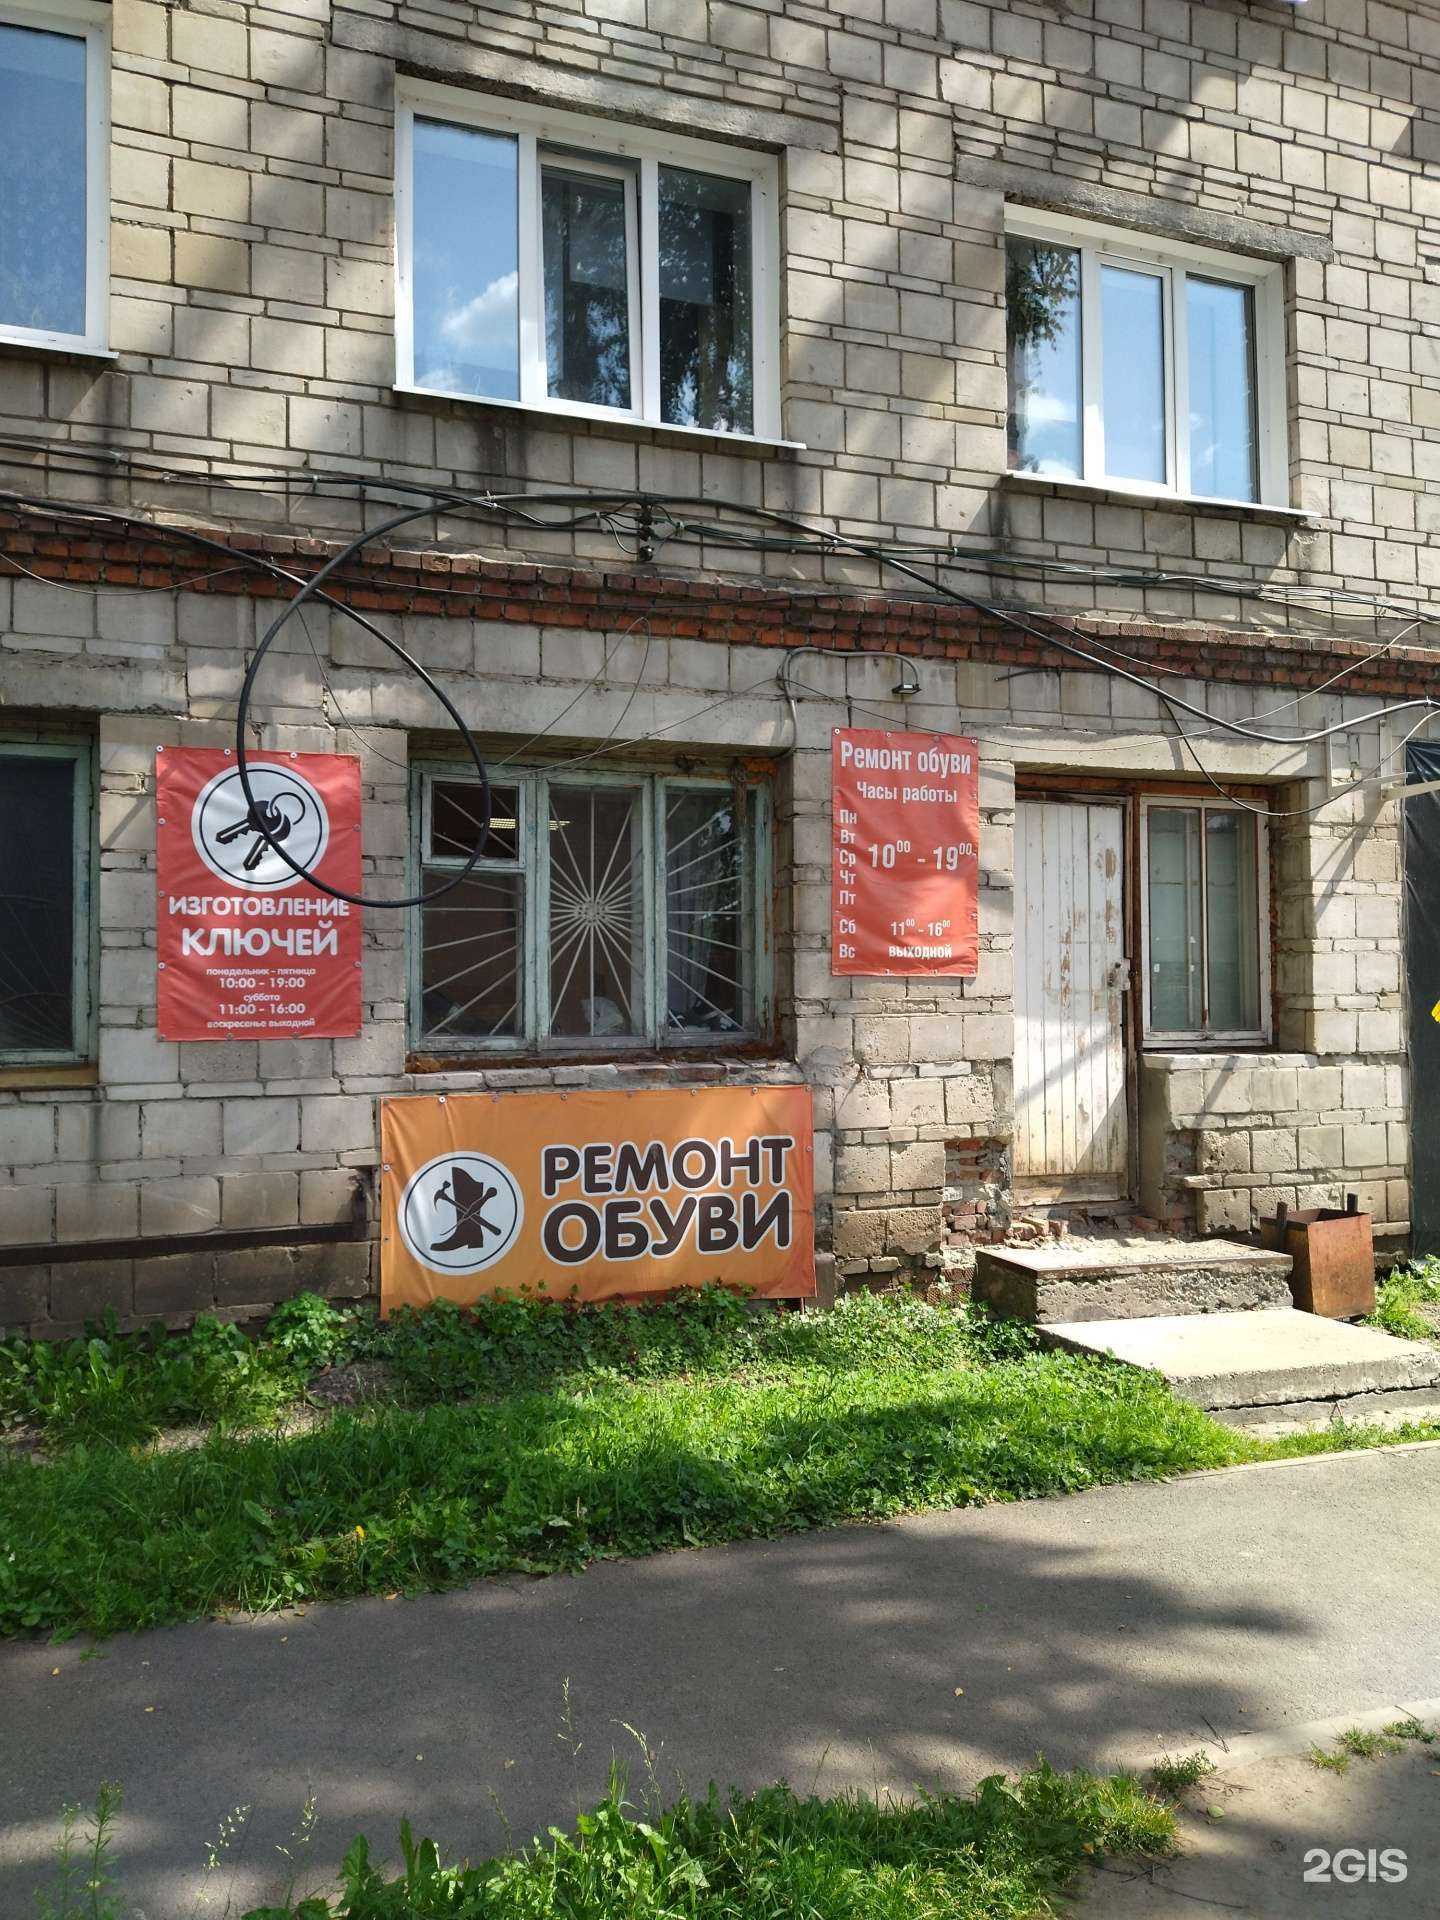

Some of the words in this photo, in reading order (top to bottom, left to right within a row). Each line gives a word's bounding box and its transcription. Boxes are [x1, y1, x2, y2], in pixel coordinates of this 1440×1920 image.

[917, 747, 971, 778] обуви
[857, 781, 898, 800] Часы
[903, 785, 957, 803] работы
[840, 830, 856, 844] Вт
[839, 850, 857, 867] Ср
[839, 870, 857, 885] Чт
[839, 890, 857, 905] Пт
[169, 897, 350, 916] ИЗГОТОВЛЕНИЕ
[839, 919, 857, 934] Сб
[182, 920, 338, 956] КЛЮЧЕЙ
[839, 943, 856, 959] Вс
[206, 967, 270, 976] понедельник
[277, 968, 316, 977] пятница
[220, 978, 256, 988] 10:00
[270, 977, 306, 988] 19:00
[243, 993, 280, 1002] суббота
[219, 1004, 256, 1015] 11:00
[270, 1003, 306, 1014] 16:00
[207, 1019, 267, 1030] воскресенье
[269, 1017, 315, 1029] выходной
[542, 1137, 795, 1197] РЕМОНТ
[542, 1191, 791, 1264] ОБУВИ
